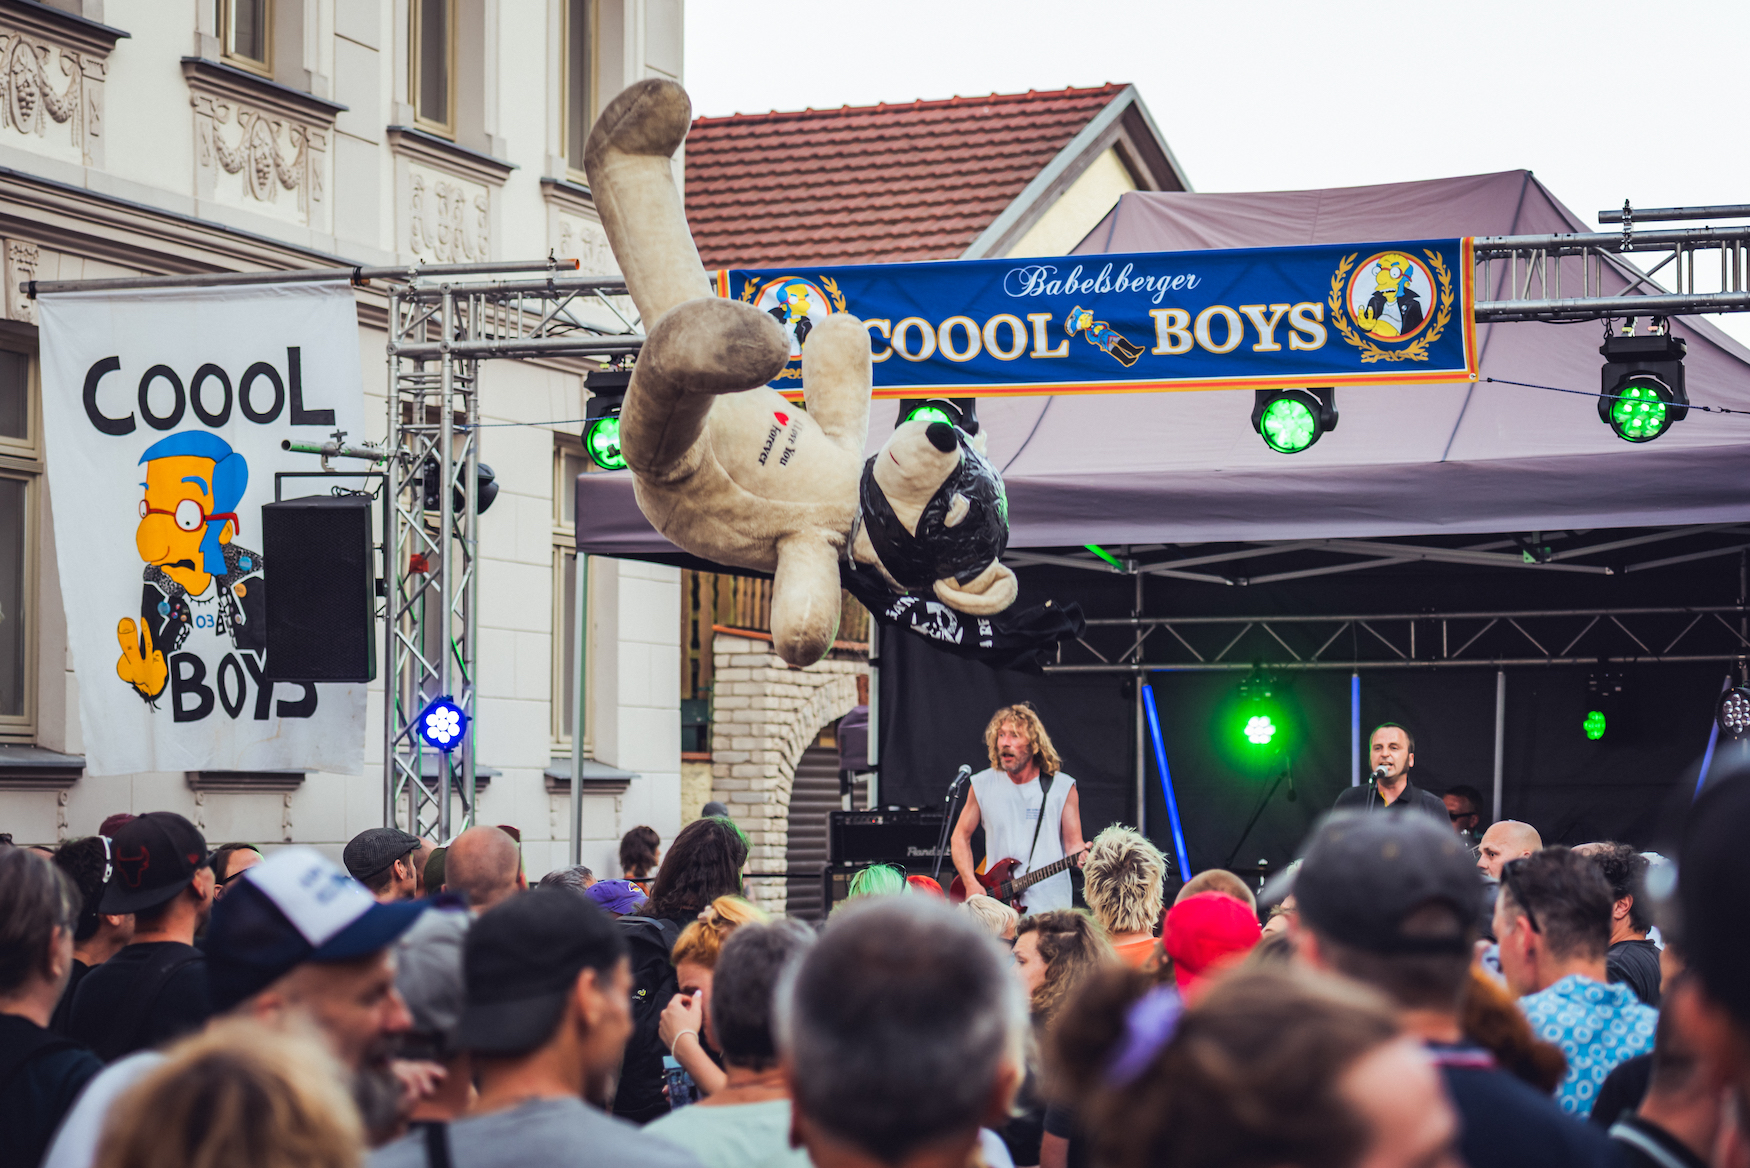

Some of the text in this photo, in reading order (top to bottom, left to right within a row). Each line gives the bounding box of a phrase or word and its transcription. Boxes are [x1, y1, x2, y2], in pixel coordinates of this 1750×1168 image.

[1003, 262, 1202, 305] Babelsberger
[860, 301, 1328, 363] COOOL BOYS
[82, 346, 336, 437] COOOL
[758, 424, 782, 467] Forever
[779, 446, 796, 467] You
[195, 613, 215, 629] 03
